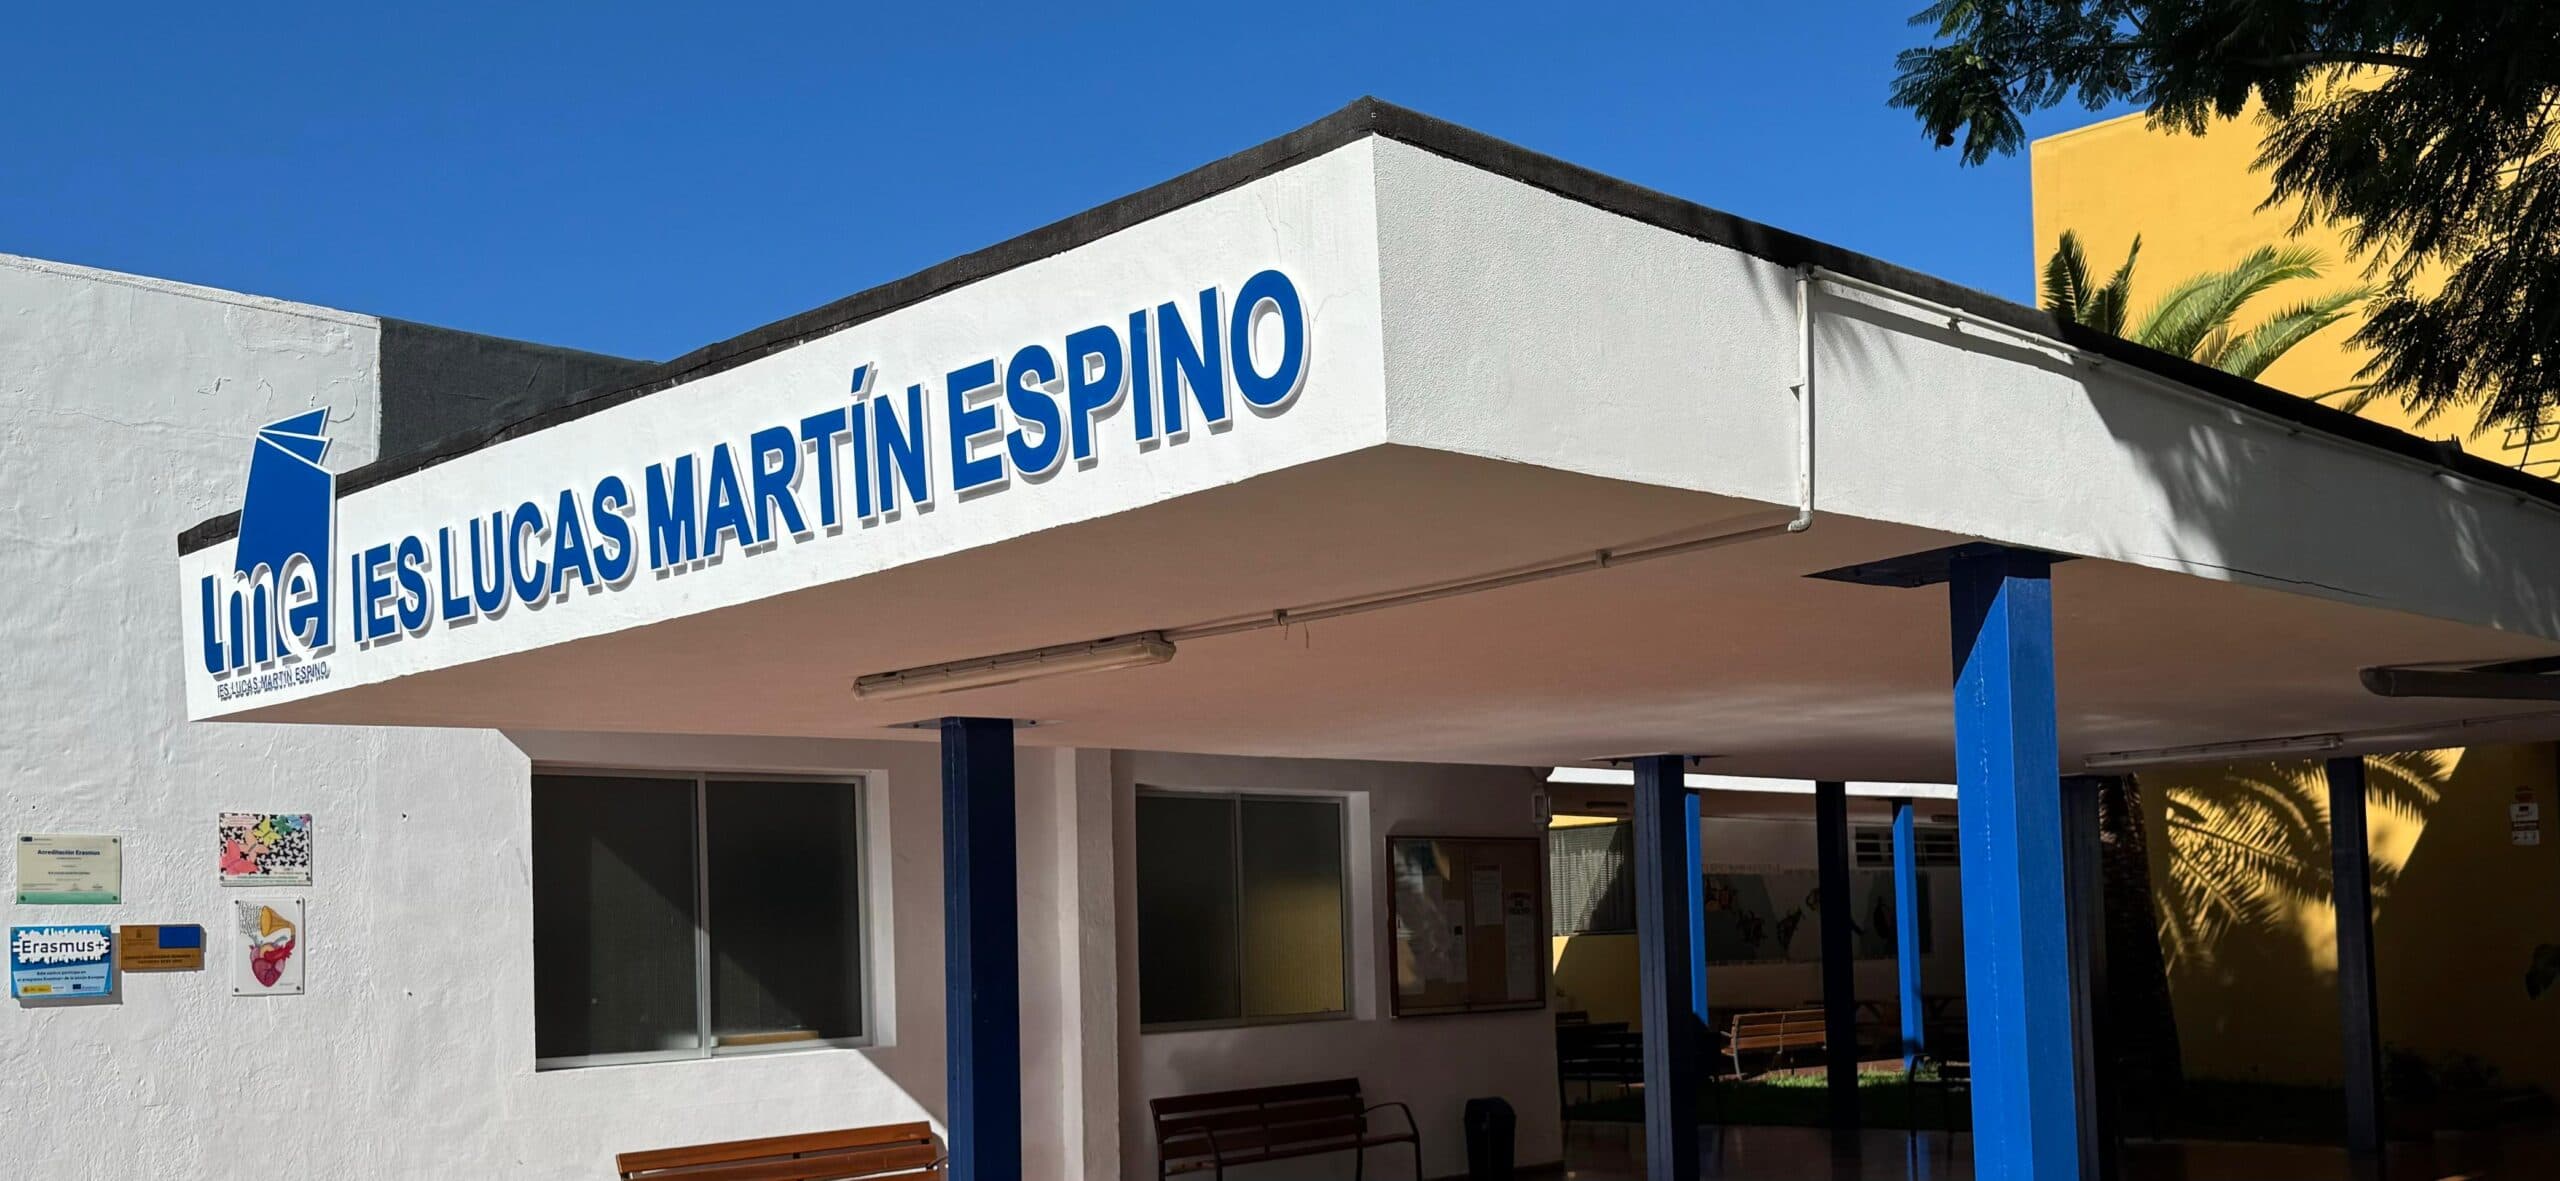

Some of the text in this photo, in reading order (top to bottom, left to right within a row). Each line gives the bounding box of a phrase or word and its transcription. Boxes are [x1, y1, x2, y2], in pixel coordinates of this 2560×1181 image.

[352, 270, 1304, 641] IES LUCAS MARTÍN ESPINO
[217, 682, 230, 699] IES
[231, 677, 259, 695] LUCAS
[295, 661, 328, 680] ESPINO
[22, 939, 105, 954] Erasmus+
